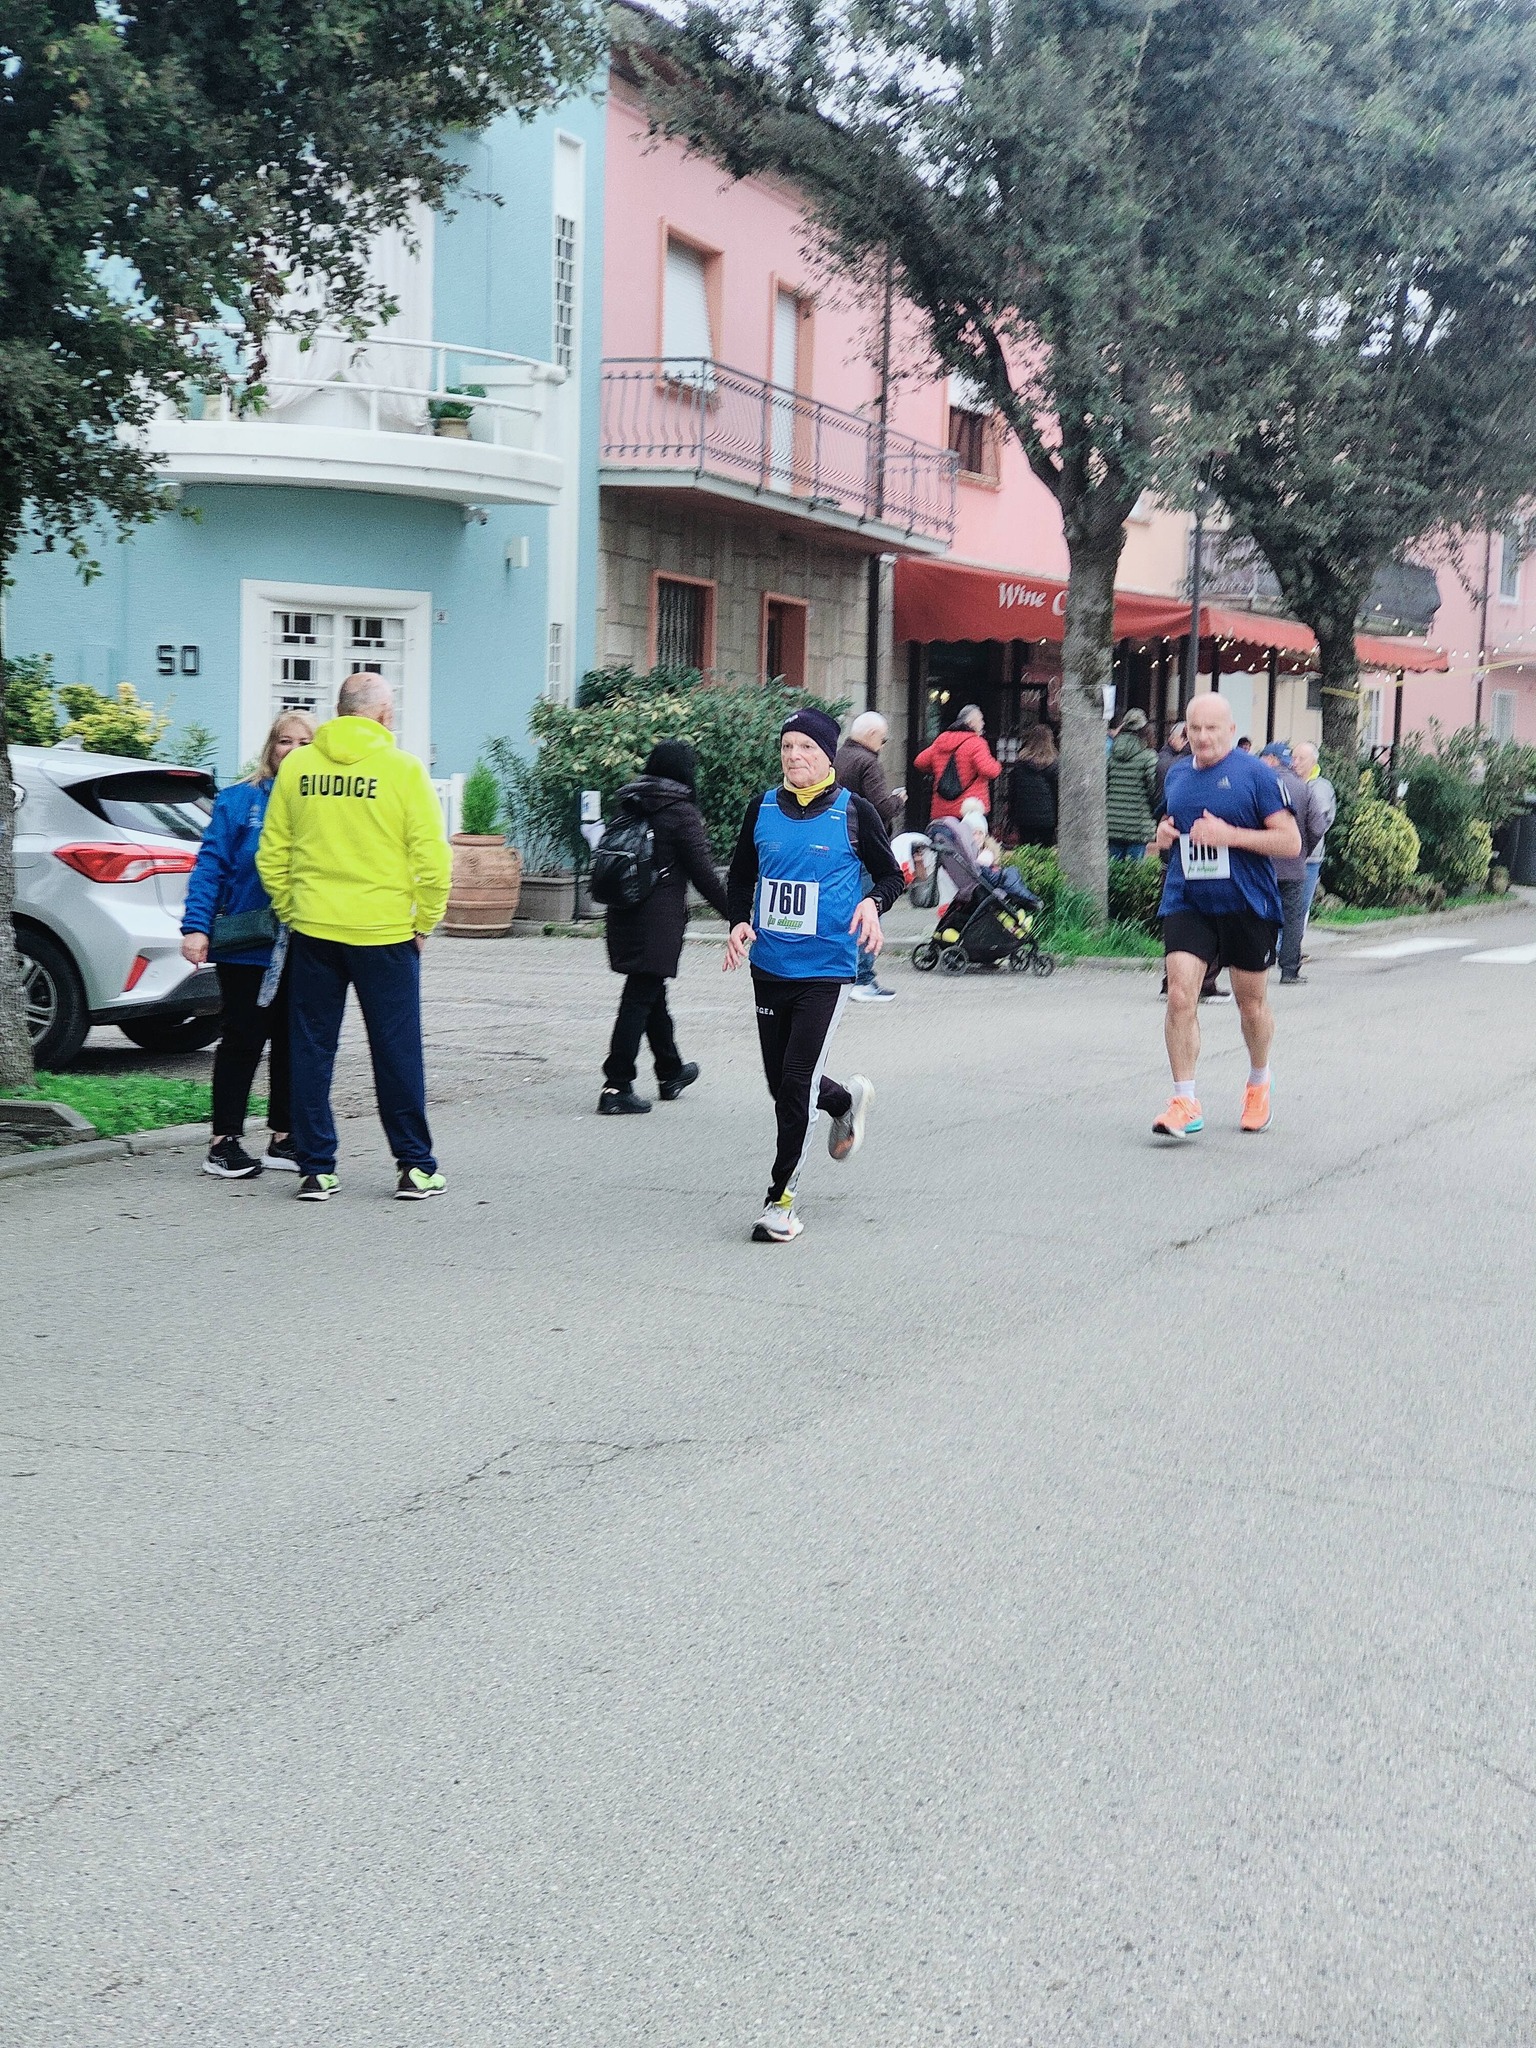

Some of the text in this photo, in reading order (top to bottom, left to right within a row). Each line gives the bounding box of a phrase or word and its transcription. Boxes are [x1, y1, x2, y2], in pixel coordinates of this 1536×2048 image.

[998, 582, 1047, 609] Wine
[156, 644, 200, 675] 50
[300, 774, 378, 799] GIUDICE
[768, 881, 807, 916] 760
